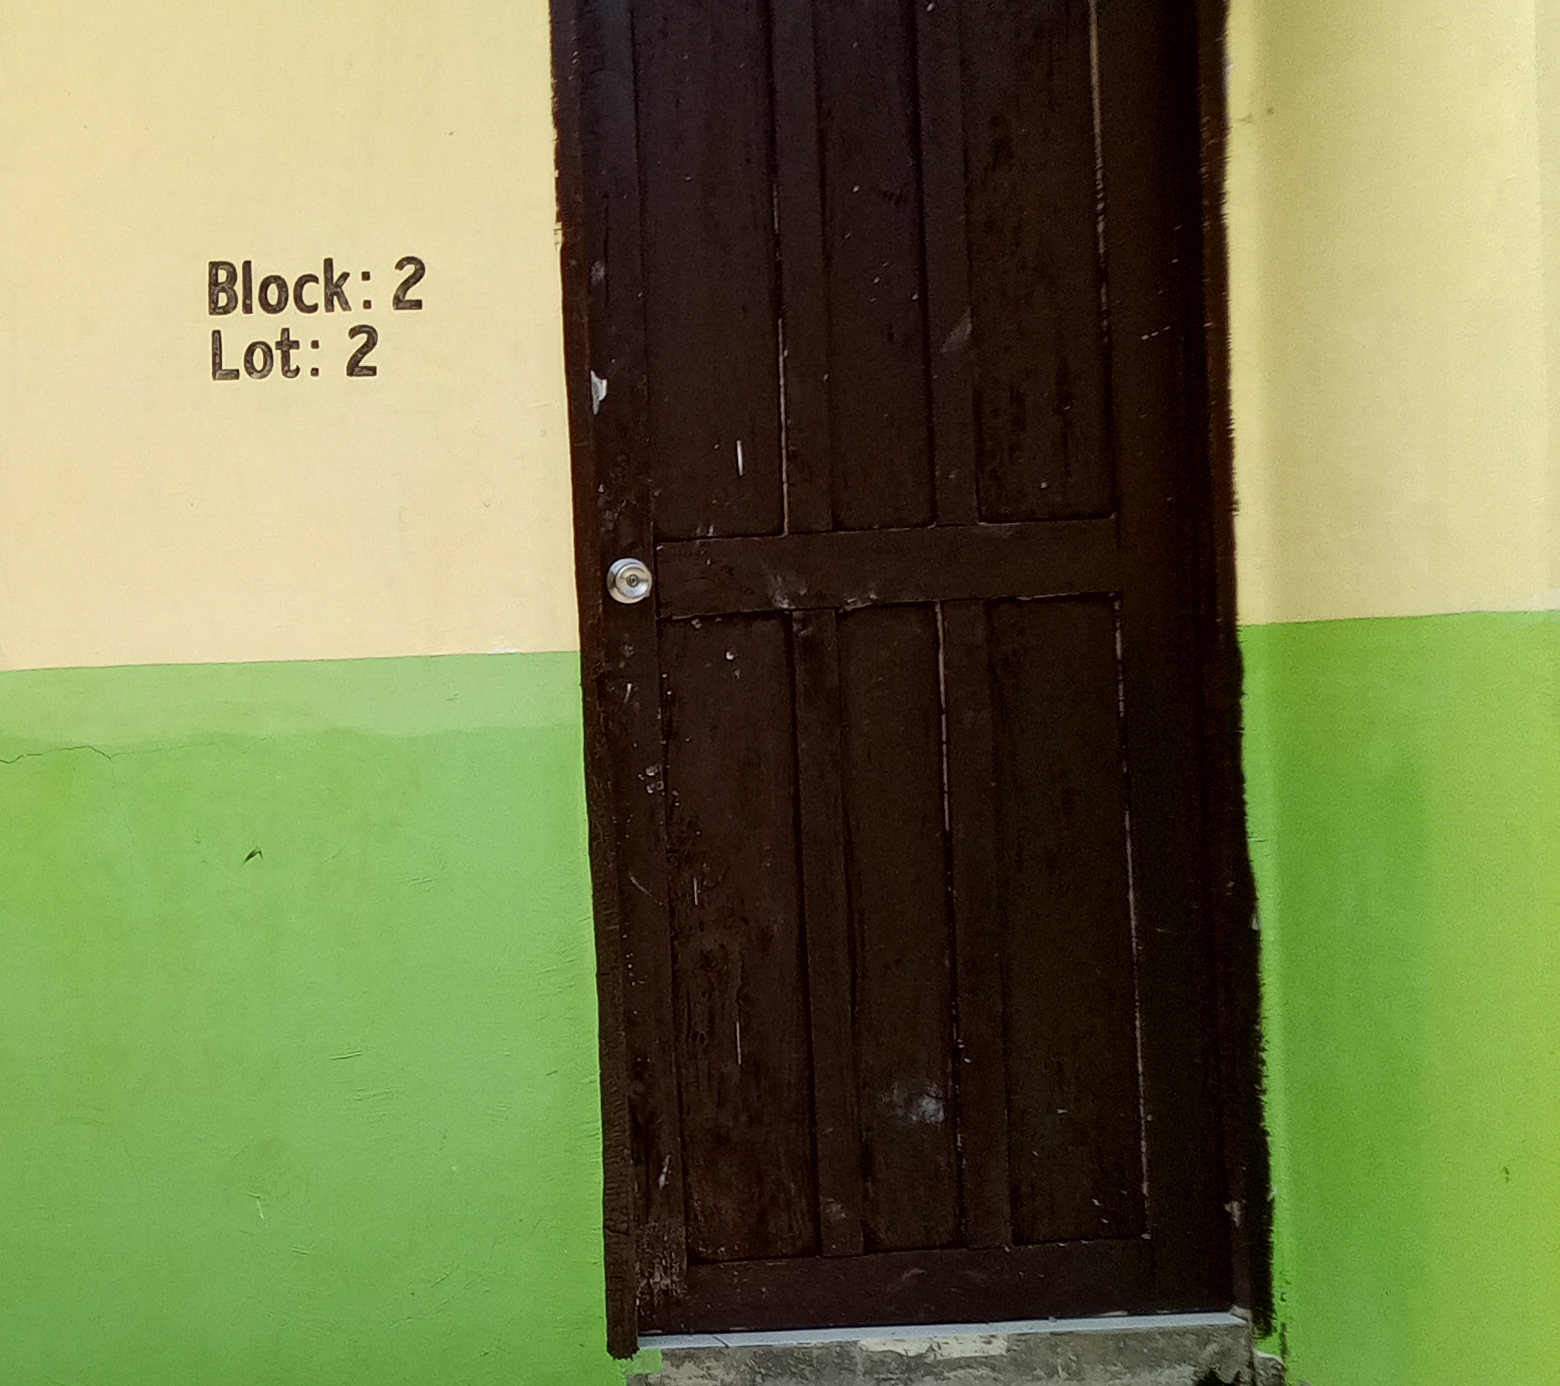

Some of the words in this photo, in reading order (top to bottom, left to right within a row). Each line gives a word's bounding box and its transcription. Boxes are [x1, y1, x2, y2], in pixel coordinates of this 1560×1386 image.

[207, 257, 372, 316] Block:
[392, 255, 426, 311] 2
[211, 327, 320, 381] Lot:
[346, 324, 379, 378] 2
